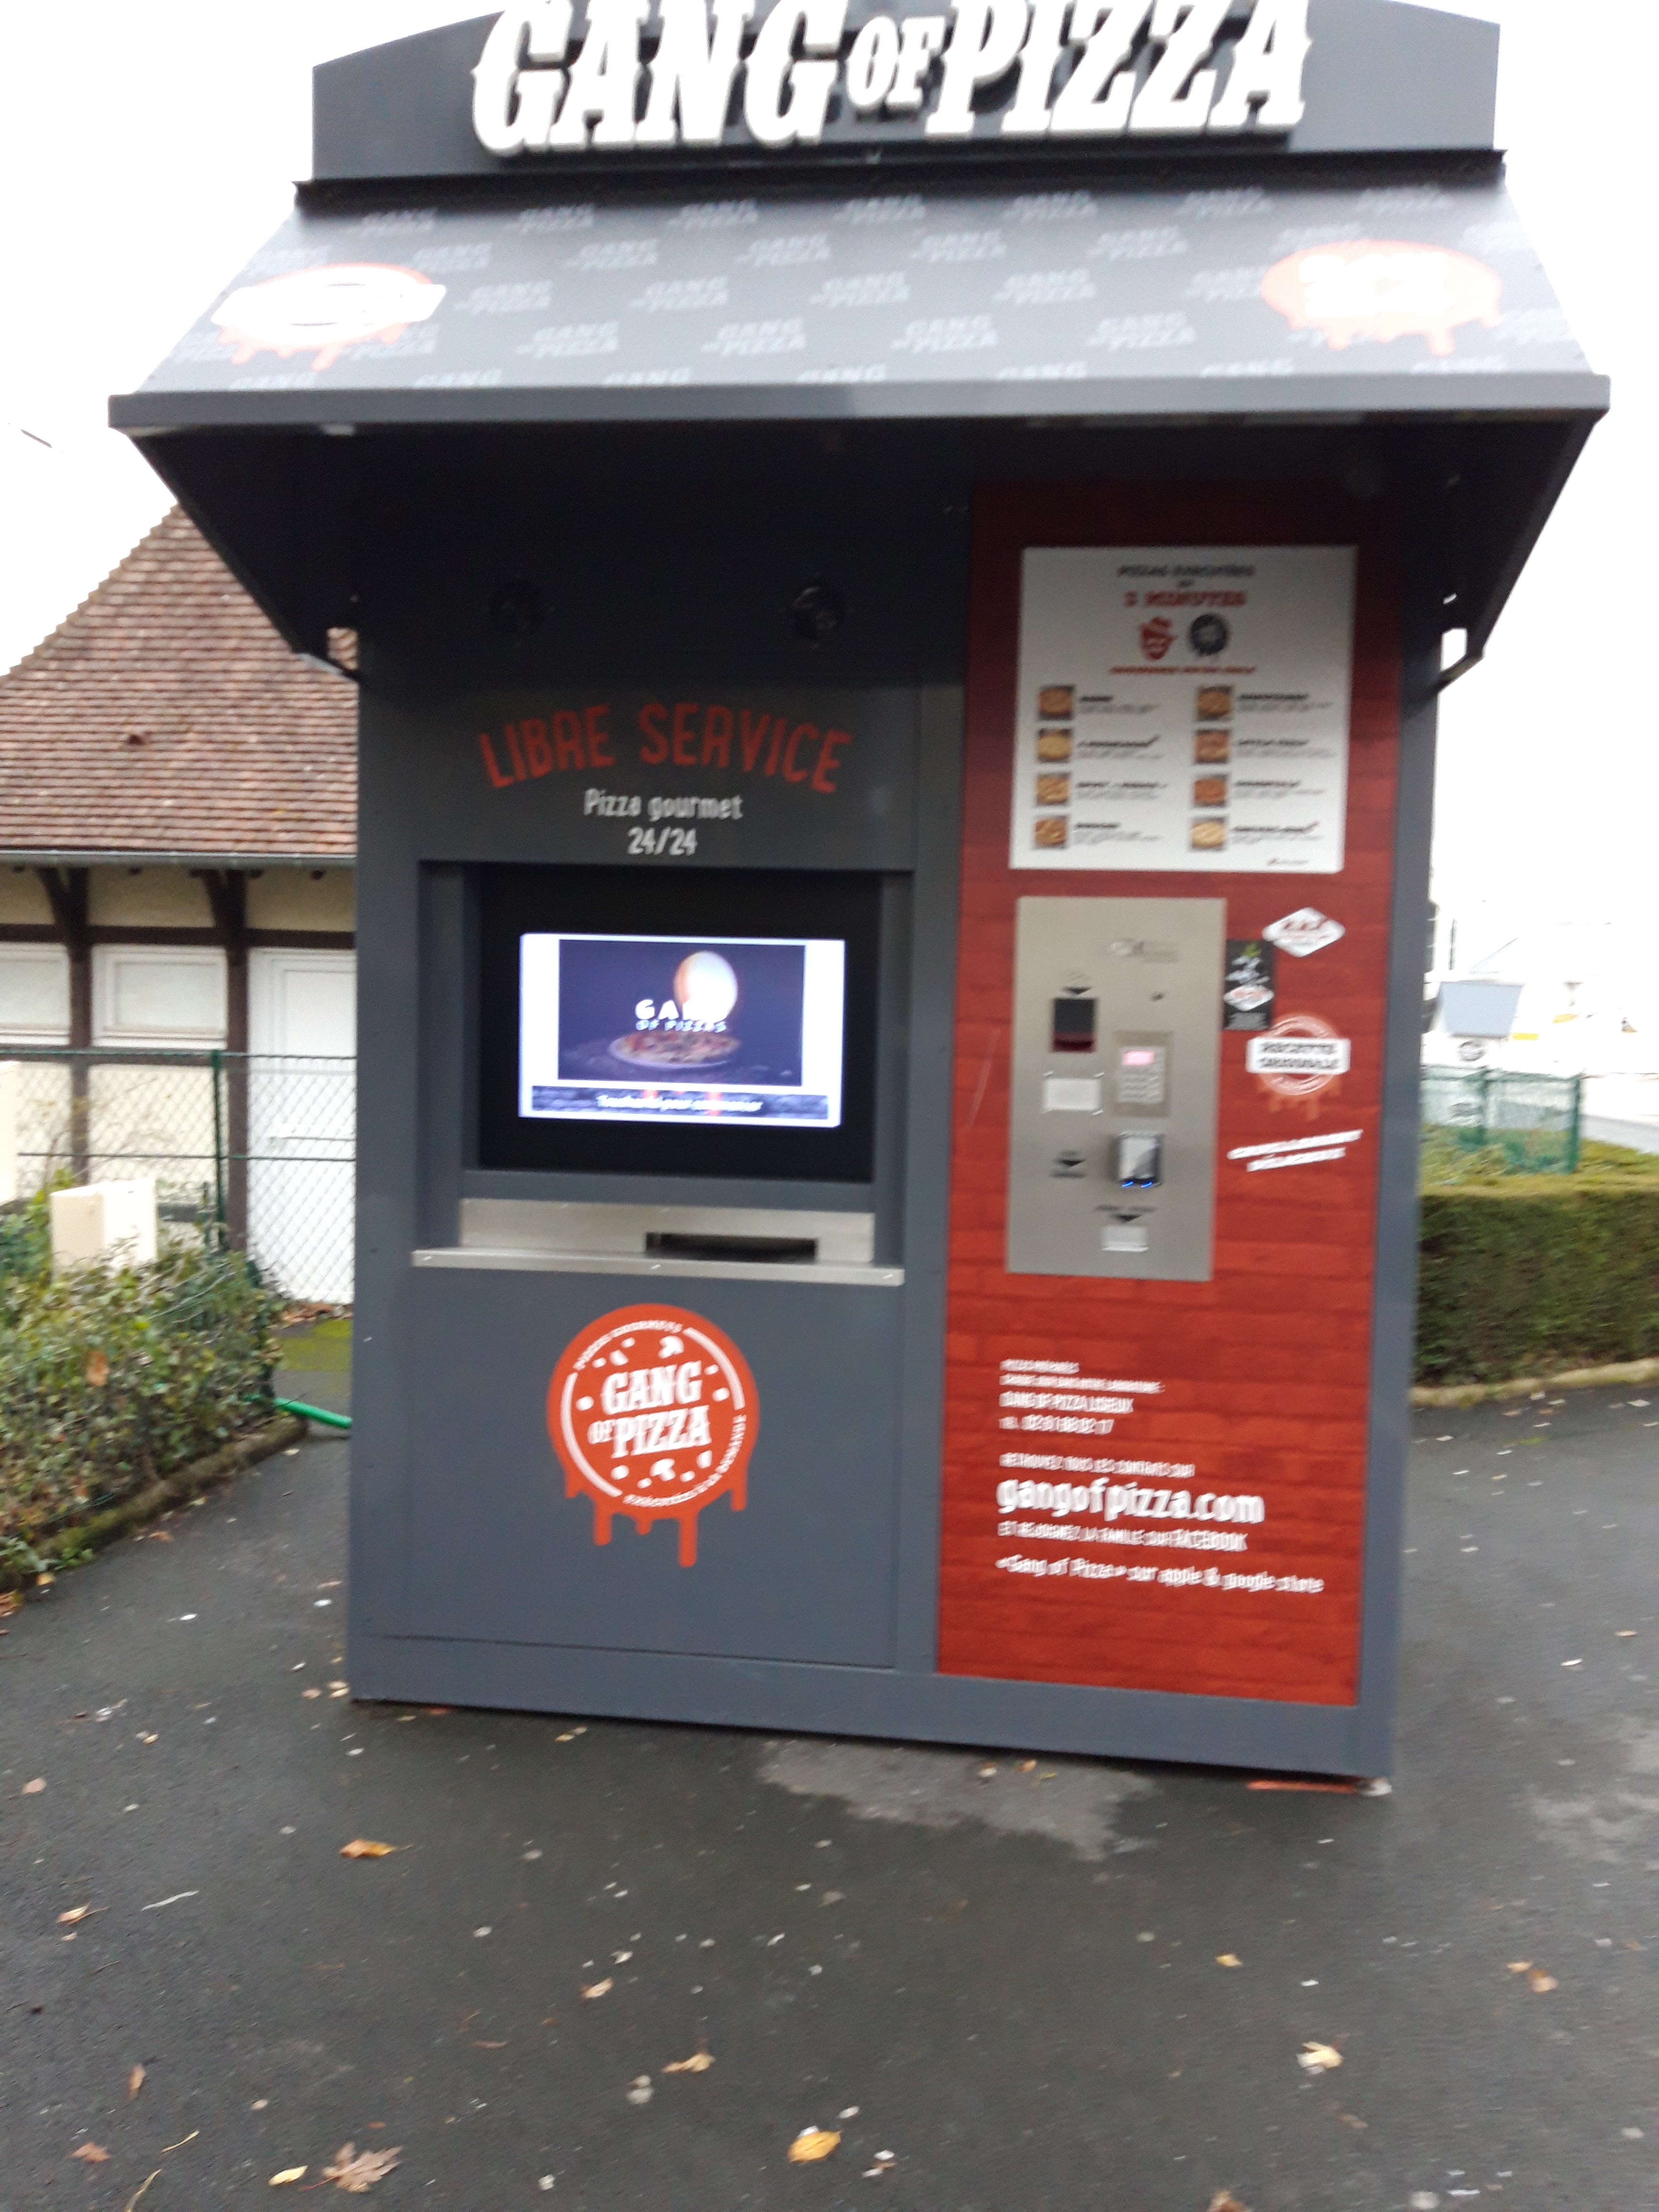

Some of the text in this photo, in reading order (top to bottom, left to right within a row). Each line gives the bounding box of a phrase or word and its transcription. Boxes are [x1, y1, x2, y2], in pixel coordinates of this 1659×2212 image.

[470, 0, 1310, 151] GANG OF PIZZA
[481, 703, 853, 794] LIBRE SERVICE
[583, 788, 744, 822] Pizza gourmet
[627, 826, 698, 856] 24/24
[600, 1360, 703, 1416] GANG
[611, 1404, 712, 1458] PIZZA
[996, 1476, 1265, 1524] gangofpizza.com
